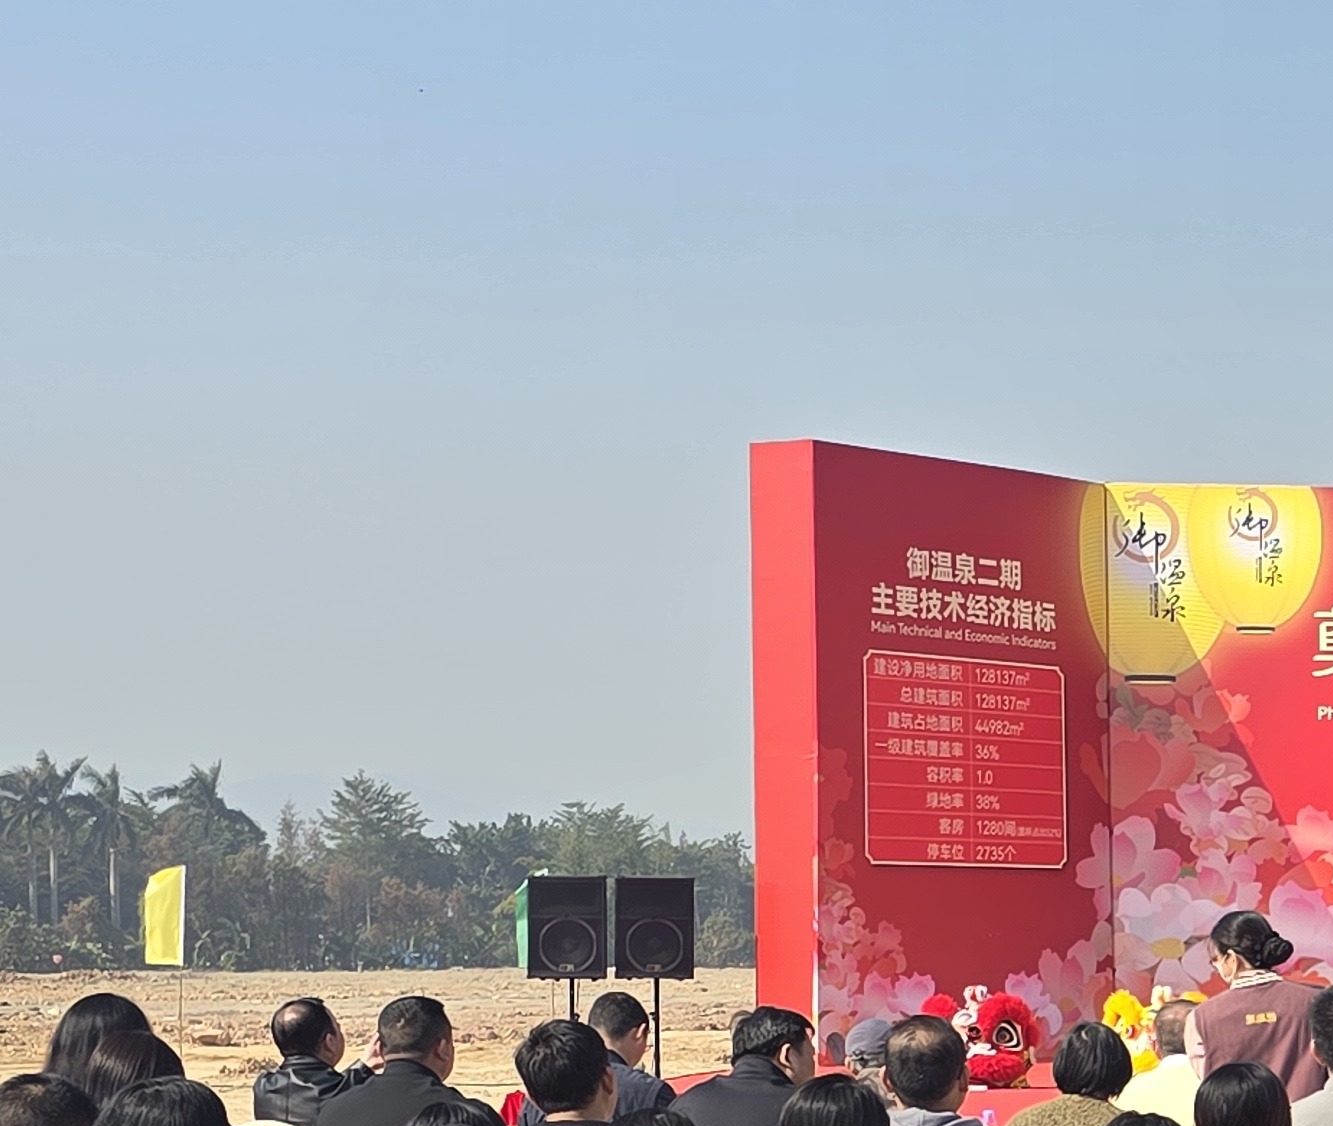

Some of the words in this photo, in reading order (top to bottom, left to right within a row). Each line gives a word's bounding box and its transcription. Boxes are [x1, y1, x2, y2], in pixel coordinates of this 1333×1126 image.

[906, 547, 1022, 591] 御温泉二期
[871, 582, 1056, 632] 主要技术经济指标
[871, 620, 896, 634] Main
[899, 622, 942, 638] Technical
[944, 628, 962, 640] and
[964, 629, 1009, 645] Economic
[1012, 634, 1056, 650] Indicators
[900, 687, 963, 707] 总建筑面积
[975, 745, 1000, 760] 36%
[927, 766, 964, 783] 容积率
[976, 770, 993, 785] 1.0
[976, 795, 1000, 810] 38%
[927, 843, 965, 861] 停车位
[976, 845, 1016, 861] 2735个
